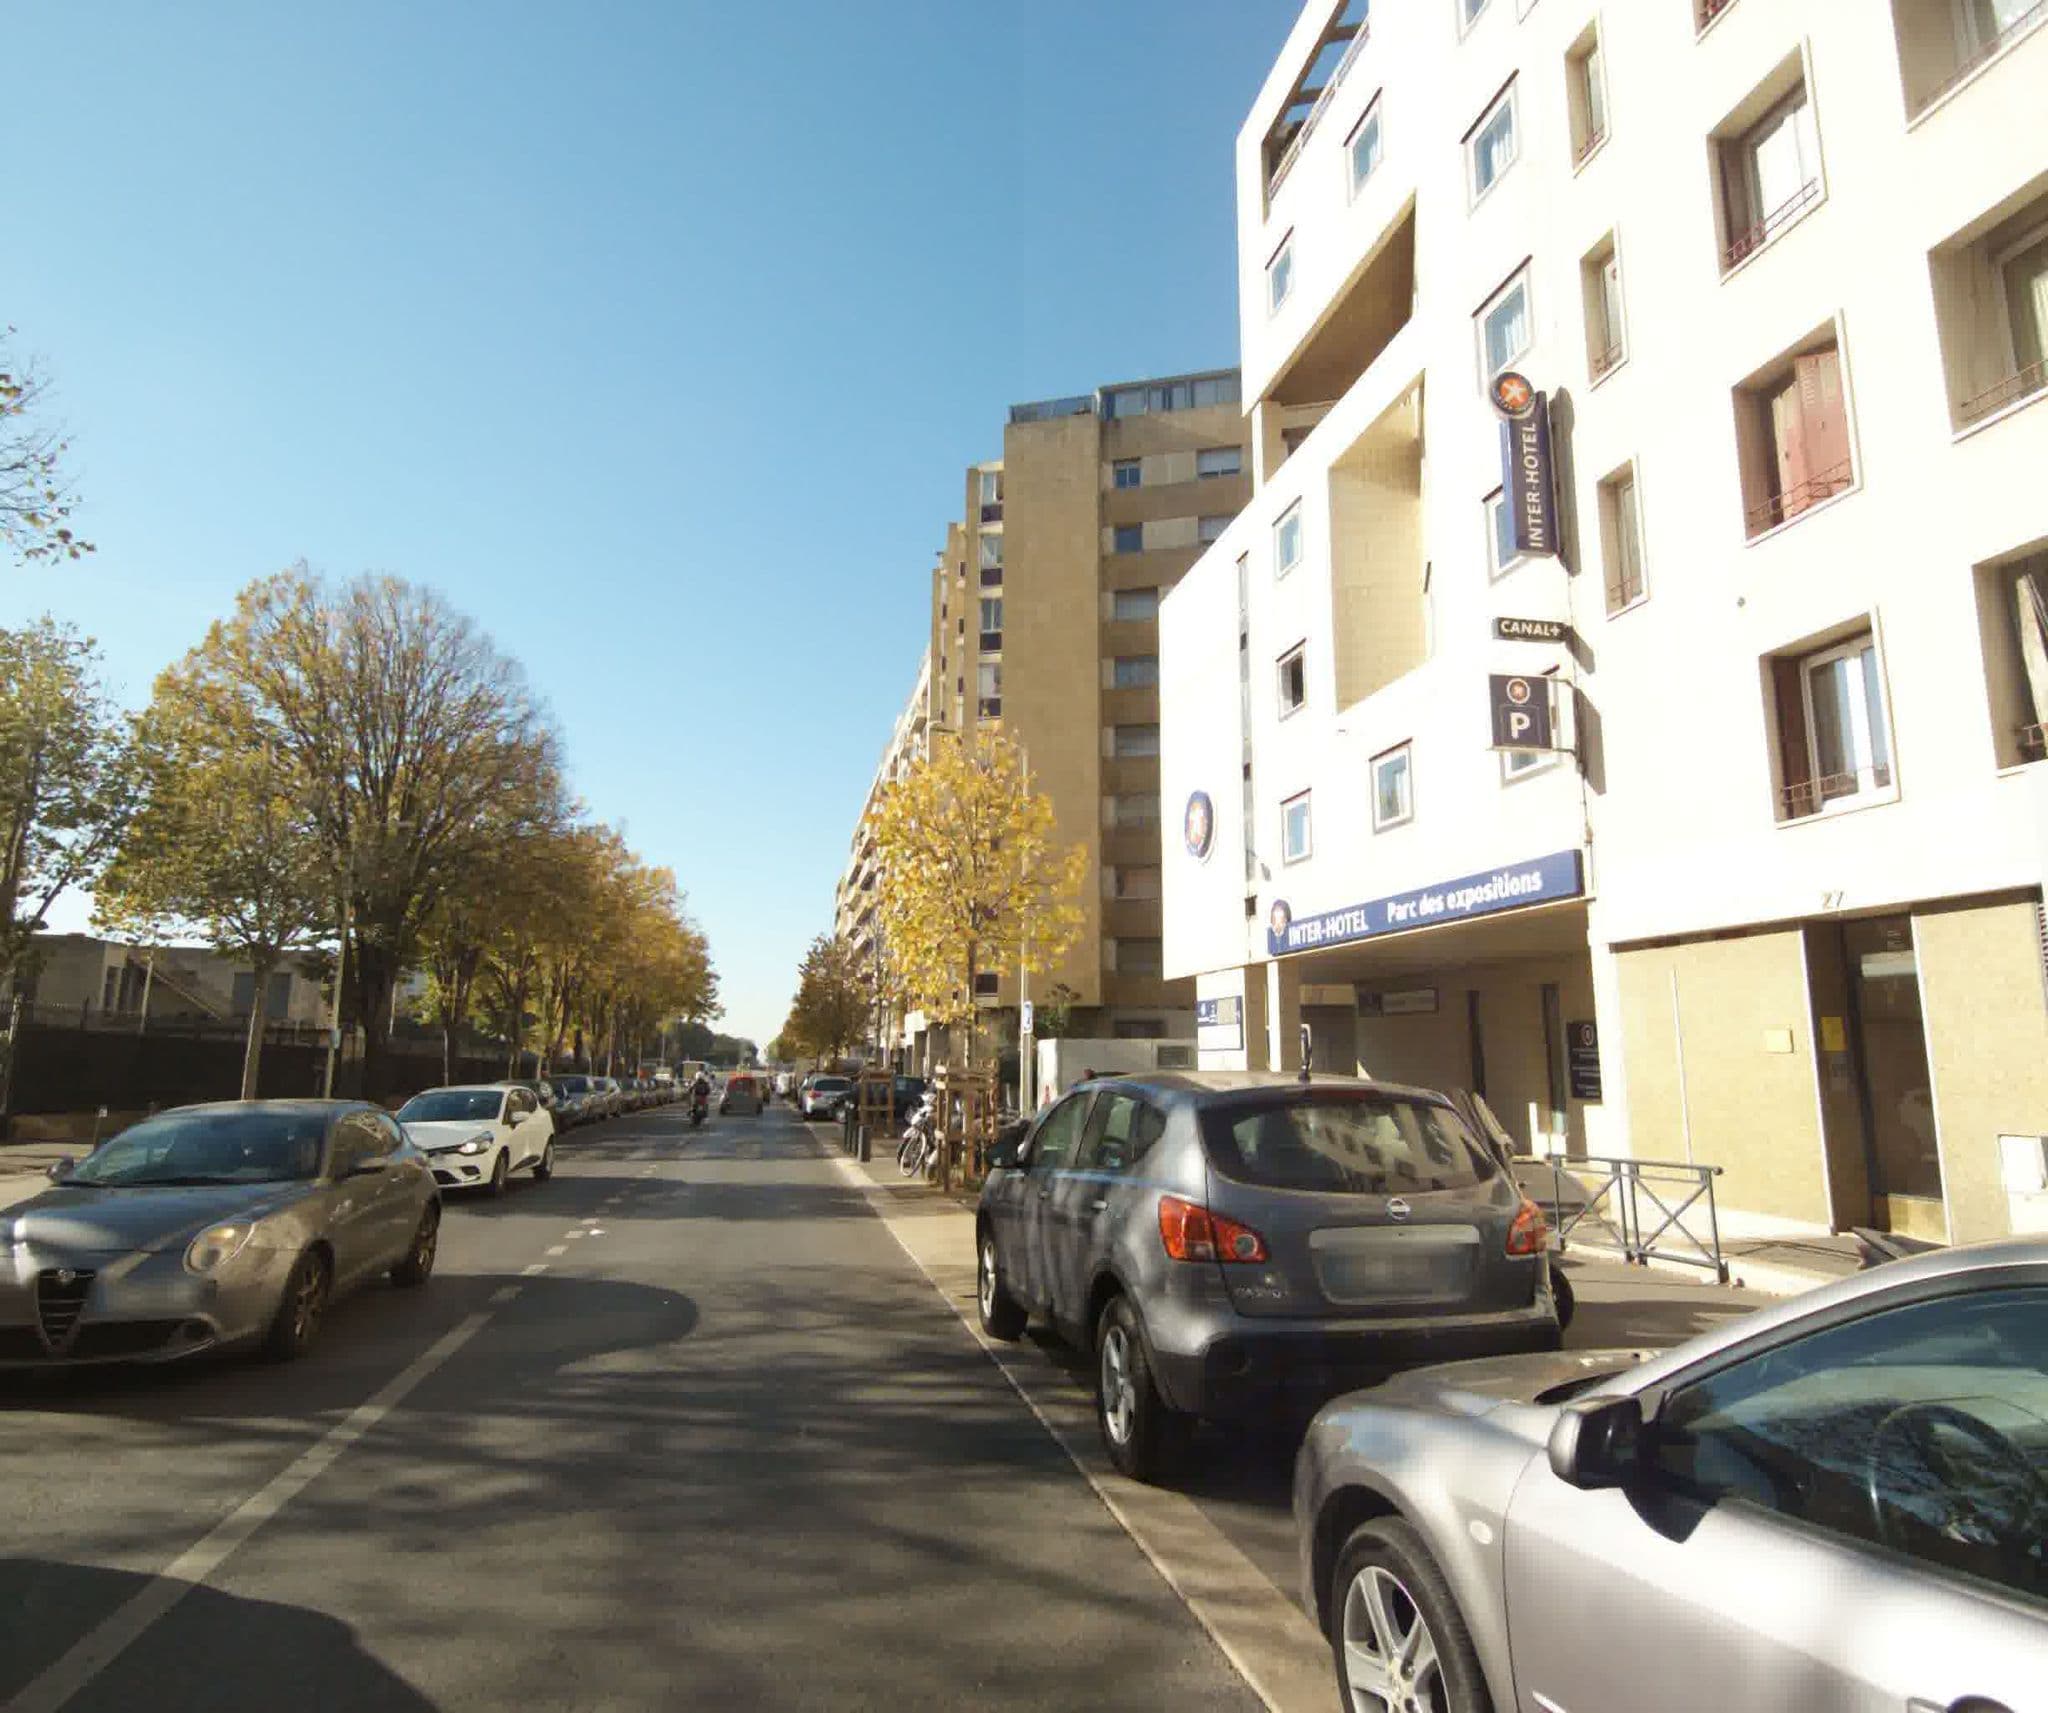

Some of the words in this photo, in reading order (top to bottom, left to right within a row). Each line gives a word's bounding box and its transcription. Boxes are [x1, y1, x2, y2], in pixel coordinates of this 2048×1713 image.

[1522, 423, 1544, 548] INTER-HOTEL
[1501, 621, 1560, 636] CANAL+
[1511, 712, 1530, 739] P
[1288, 909, 1369, 947] INTER-HOTEL
[1387, 900, 1417, 923] Parc
[1419, 893, 1445, 916] des
[1447, 870, 1543, 911] expositions
